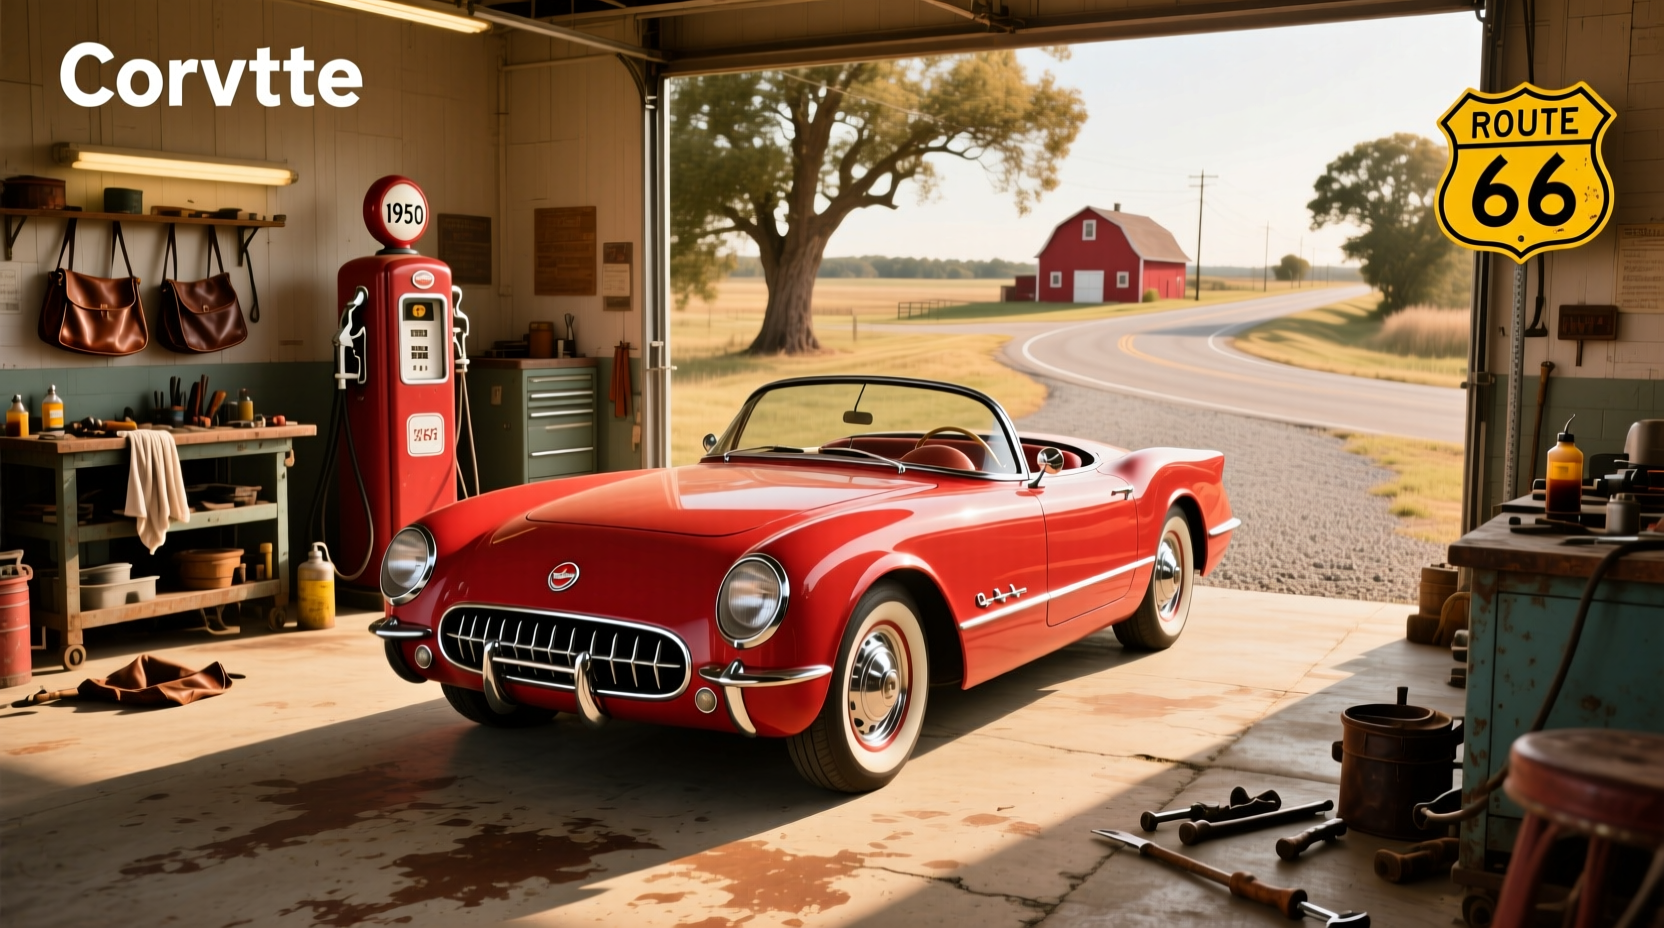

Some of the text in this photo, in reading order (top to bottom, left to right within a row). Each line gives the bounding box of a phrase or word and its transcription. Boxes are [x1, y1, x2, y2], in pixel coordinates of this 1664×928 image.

[1472, 107, 1578, 138] ROUTE
[1472, 153, 1576, 227] 66
[386, 202, 424, 225] 1950
